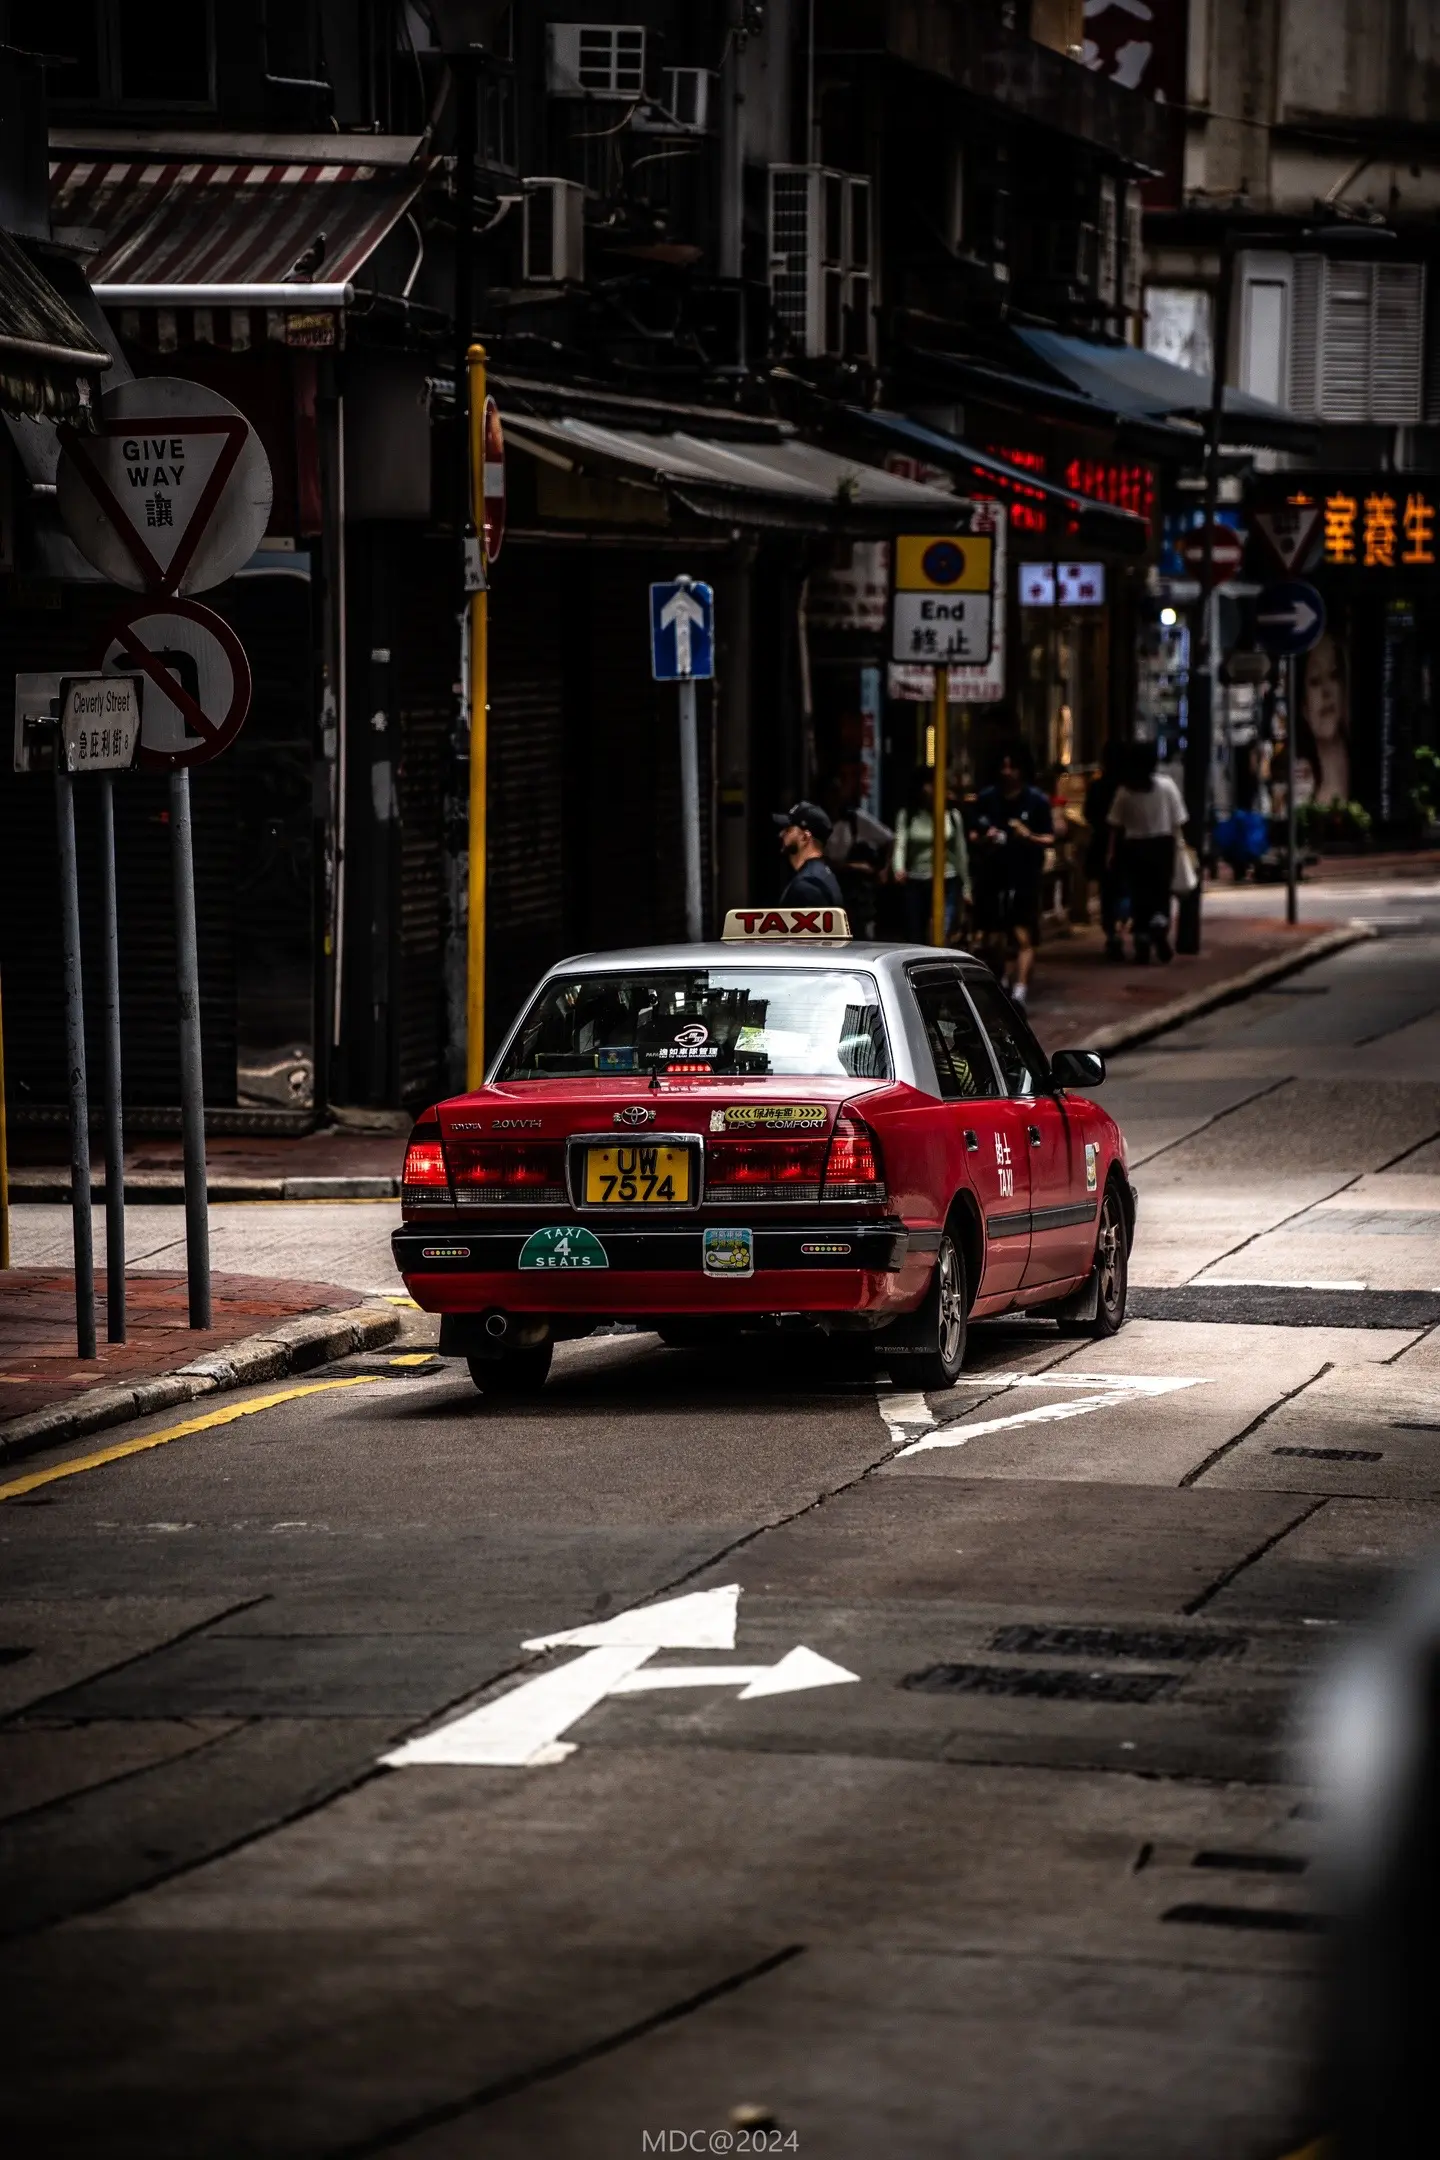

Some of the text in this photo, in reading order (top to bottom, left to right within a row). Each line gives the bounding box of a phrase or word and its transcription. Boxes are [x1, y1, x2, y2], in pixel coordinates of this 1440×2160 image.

[123, 439, 184, 461] GIVE
[127, 465, 184, 487] WAY
[145, 495, 173, 527] 讓
[1286, 489, 1437, 567] 室養生
[921, 602, 964, 621] End
[911, 627, 970, 655] 終止
[74, 690, 130, 717] Cleverly Street
[79, 729, 122, 759] 急庇利街
[735, 911, 833, 934] TAXI
[450, 1122, 482, 1130] TOYOTA
[728, 1119, 827, 1130] LPG COMFORT
[994, 1132, 1012, 1165] 的士
[617, 1148, 658, 1175] UW
[599, 1175, 675, 1201] 7574
[997, 1168, 1014, 1197] TAXI
[544, 1227, 582, 1240] TAXI
[553, 1237, 572, 1256] 4
[535, 1256, 592, 1267] SEATS
